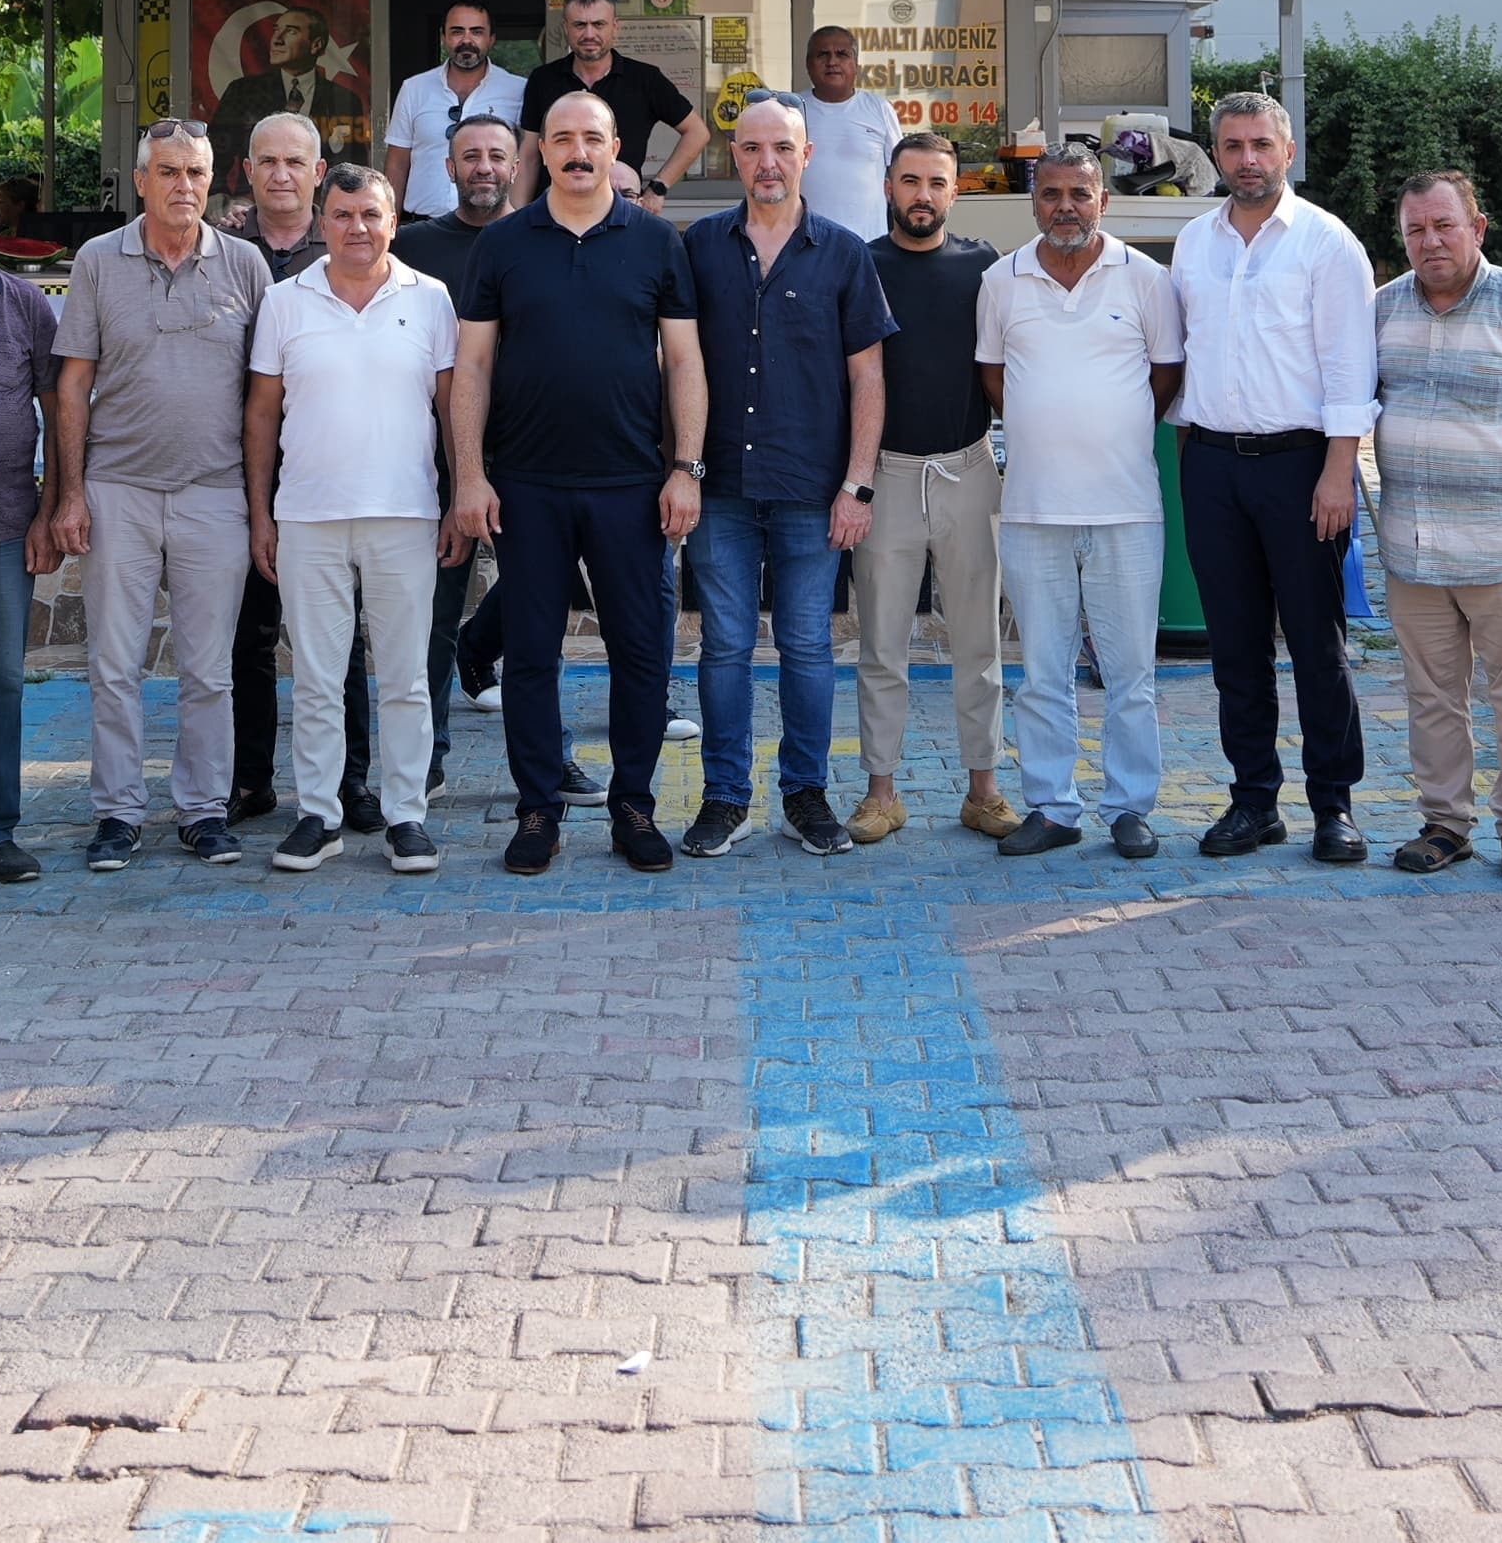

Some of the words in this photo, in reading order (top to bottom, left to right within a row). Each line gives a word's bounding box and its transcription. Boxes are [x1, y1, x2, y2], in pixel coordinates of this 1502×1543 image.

[851, 27, 917, 51] YAALTI
[921, 23, 997, 51] AKDENİZ
[856, 59, 896, 89] KSİ
[903, 60, 998, 89] DURAĞI
[930, 101, 959, 125] 08
[968, 100, 997, 124] 14
